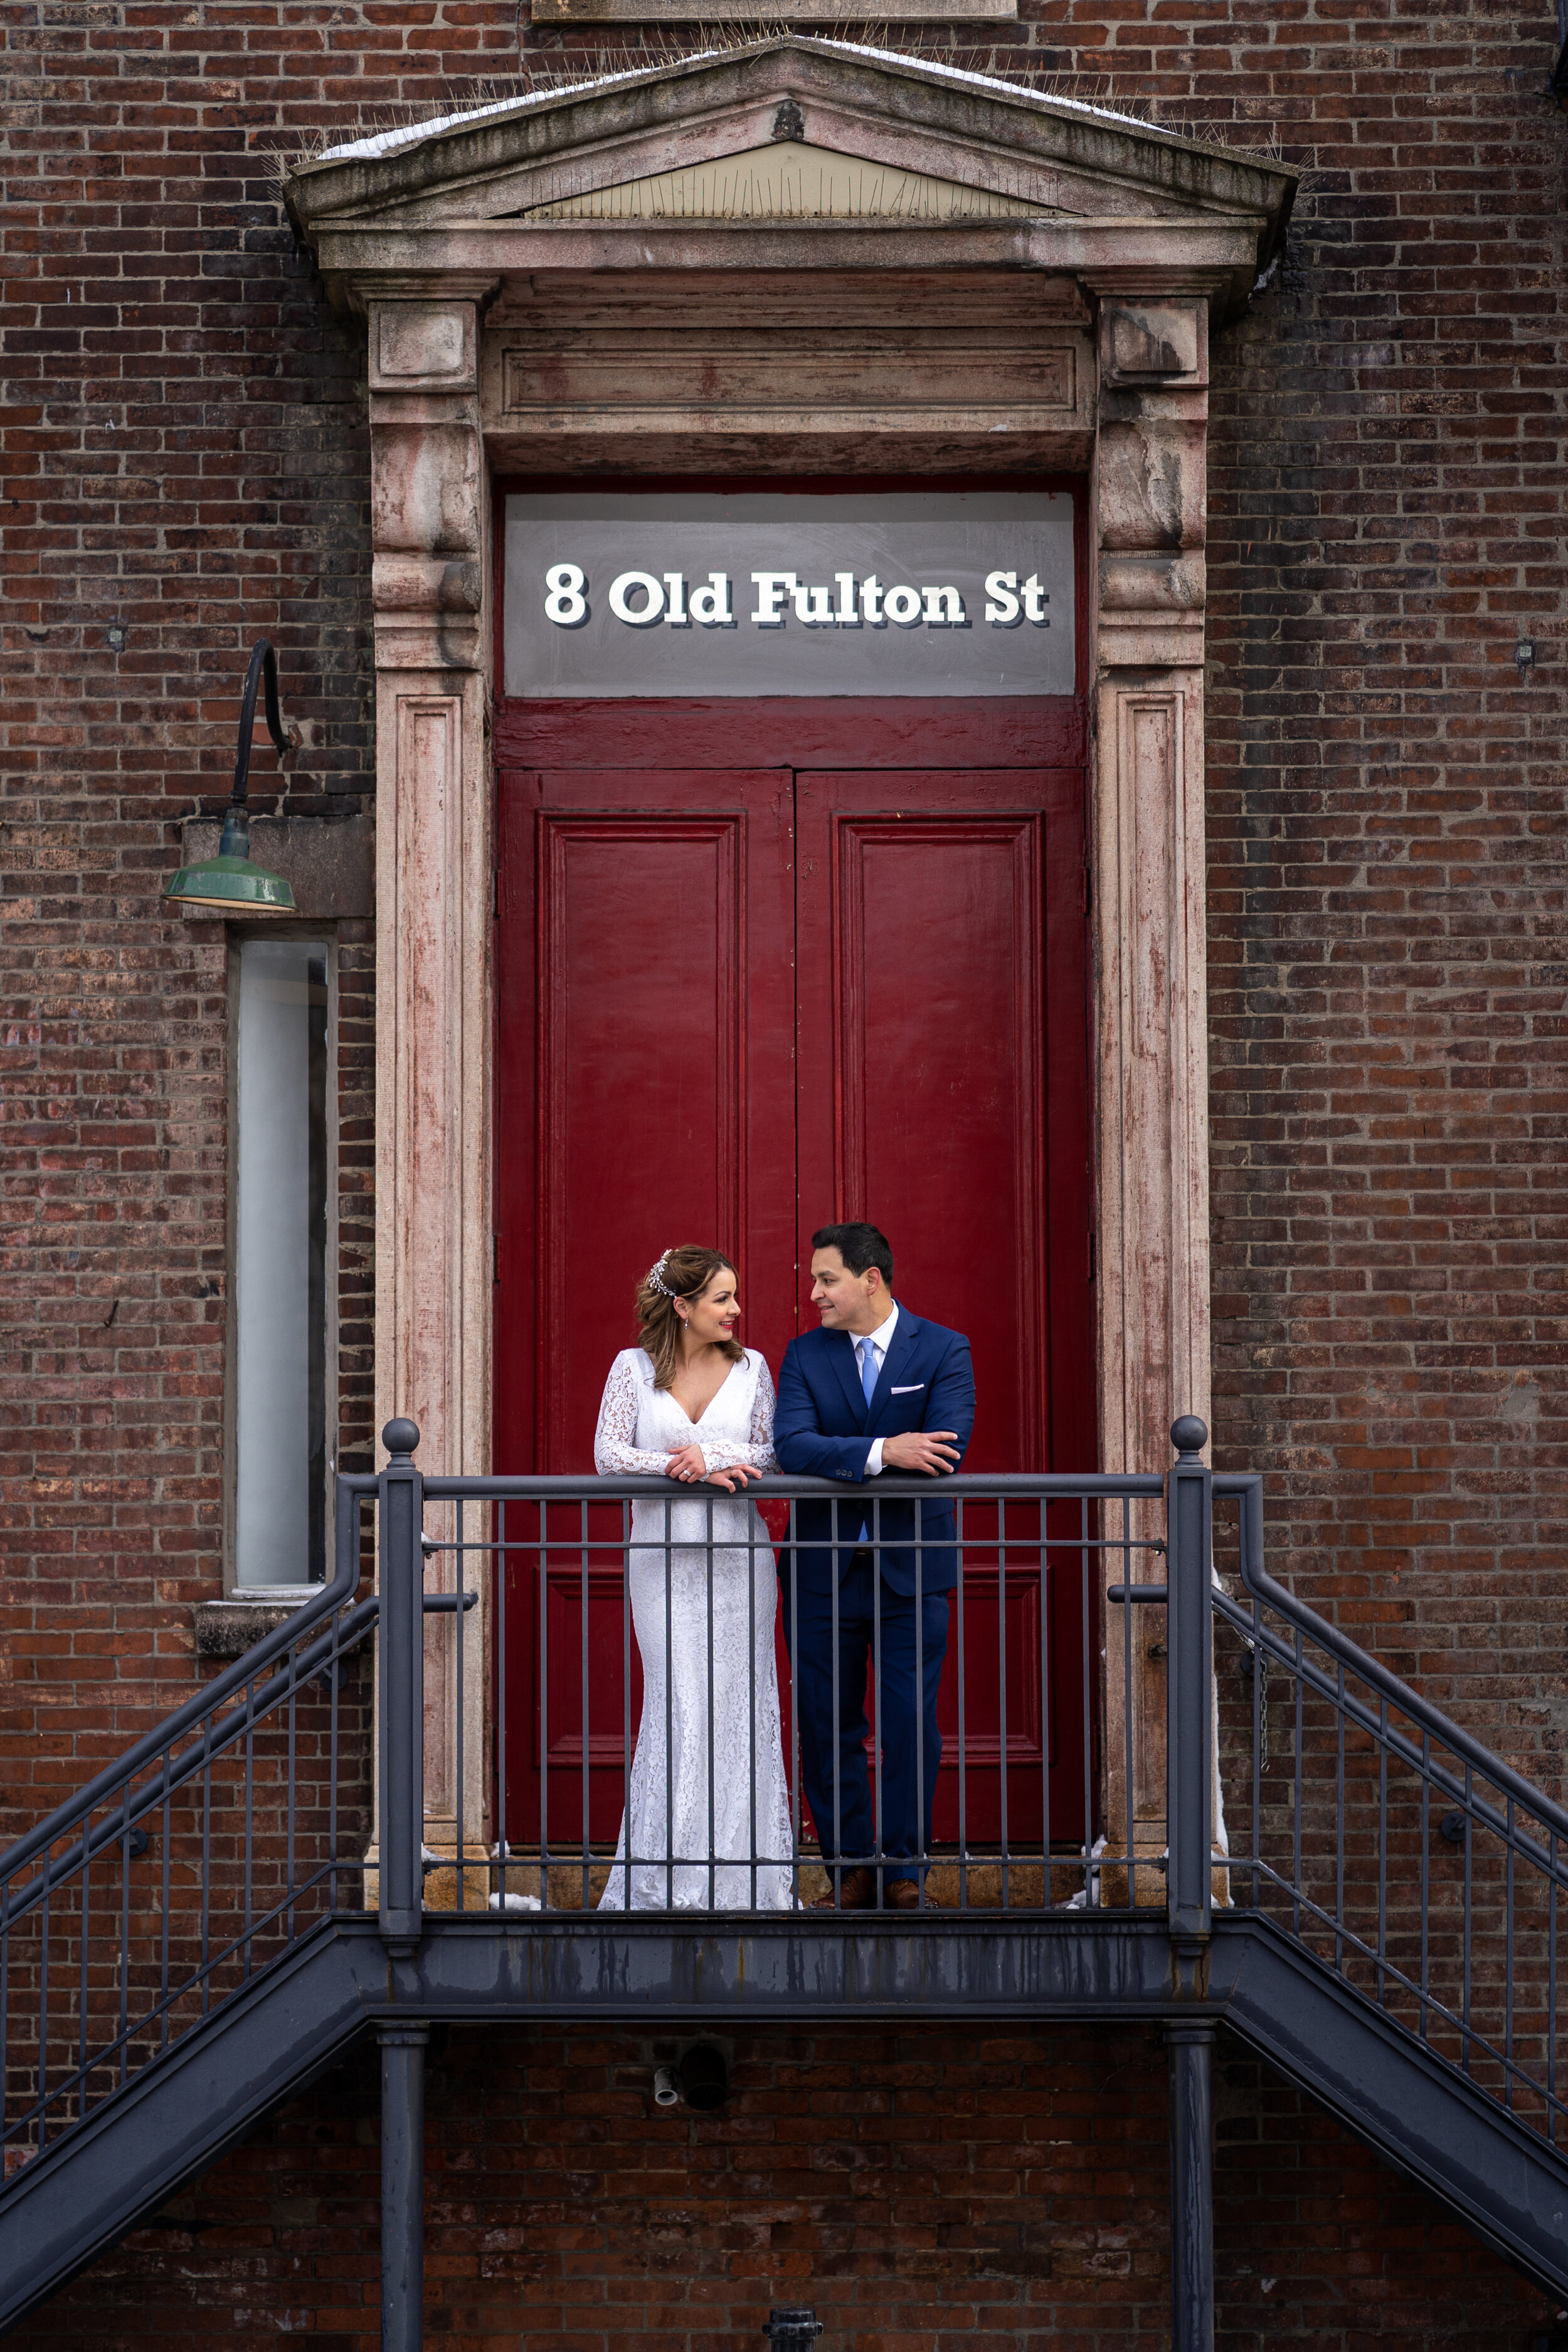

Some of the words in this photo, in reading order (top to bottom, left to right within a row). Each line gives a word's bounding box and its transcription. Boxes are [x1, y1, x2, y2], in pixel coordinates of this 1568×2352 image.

[544, 563, 588, 626] 8
[608, 571, 735, 626] Old
[750, 571, 968, 625] Fulton
[984, 570, 1047, 625] St
